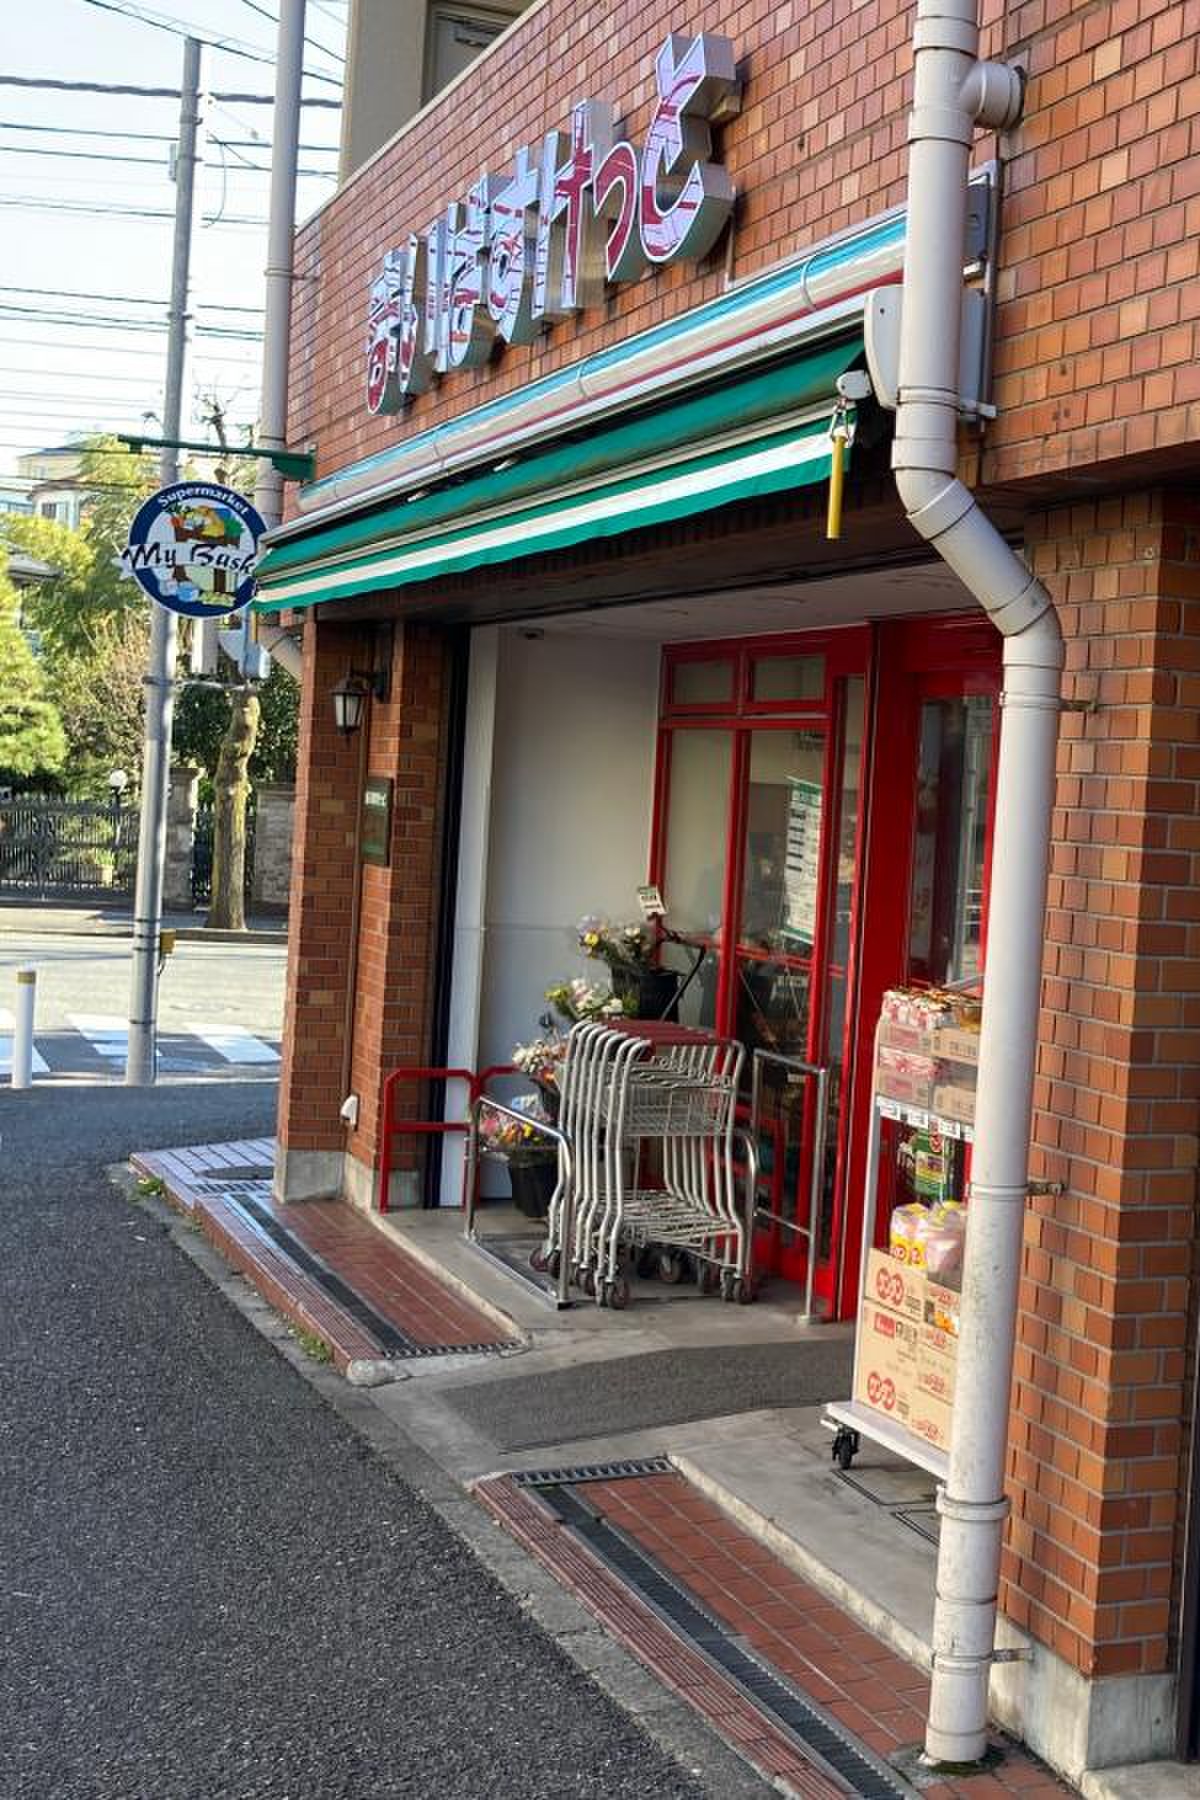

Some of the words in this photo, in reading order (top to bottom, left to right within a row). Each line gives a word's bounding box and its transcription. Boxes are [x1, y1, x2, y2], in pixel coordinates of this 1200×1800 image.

[157, 485, 250, 515] Supermarket
[122, 541, 177, 568] My
[190, 543, 256, 575] Bask
